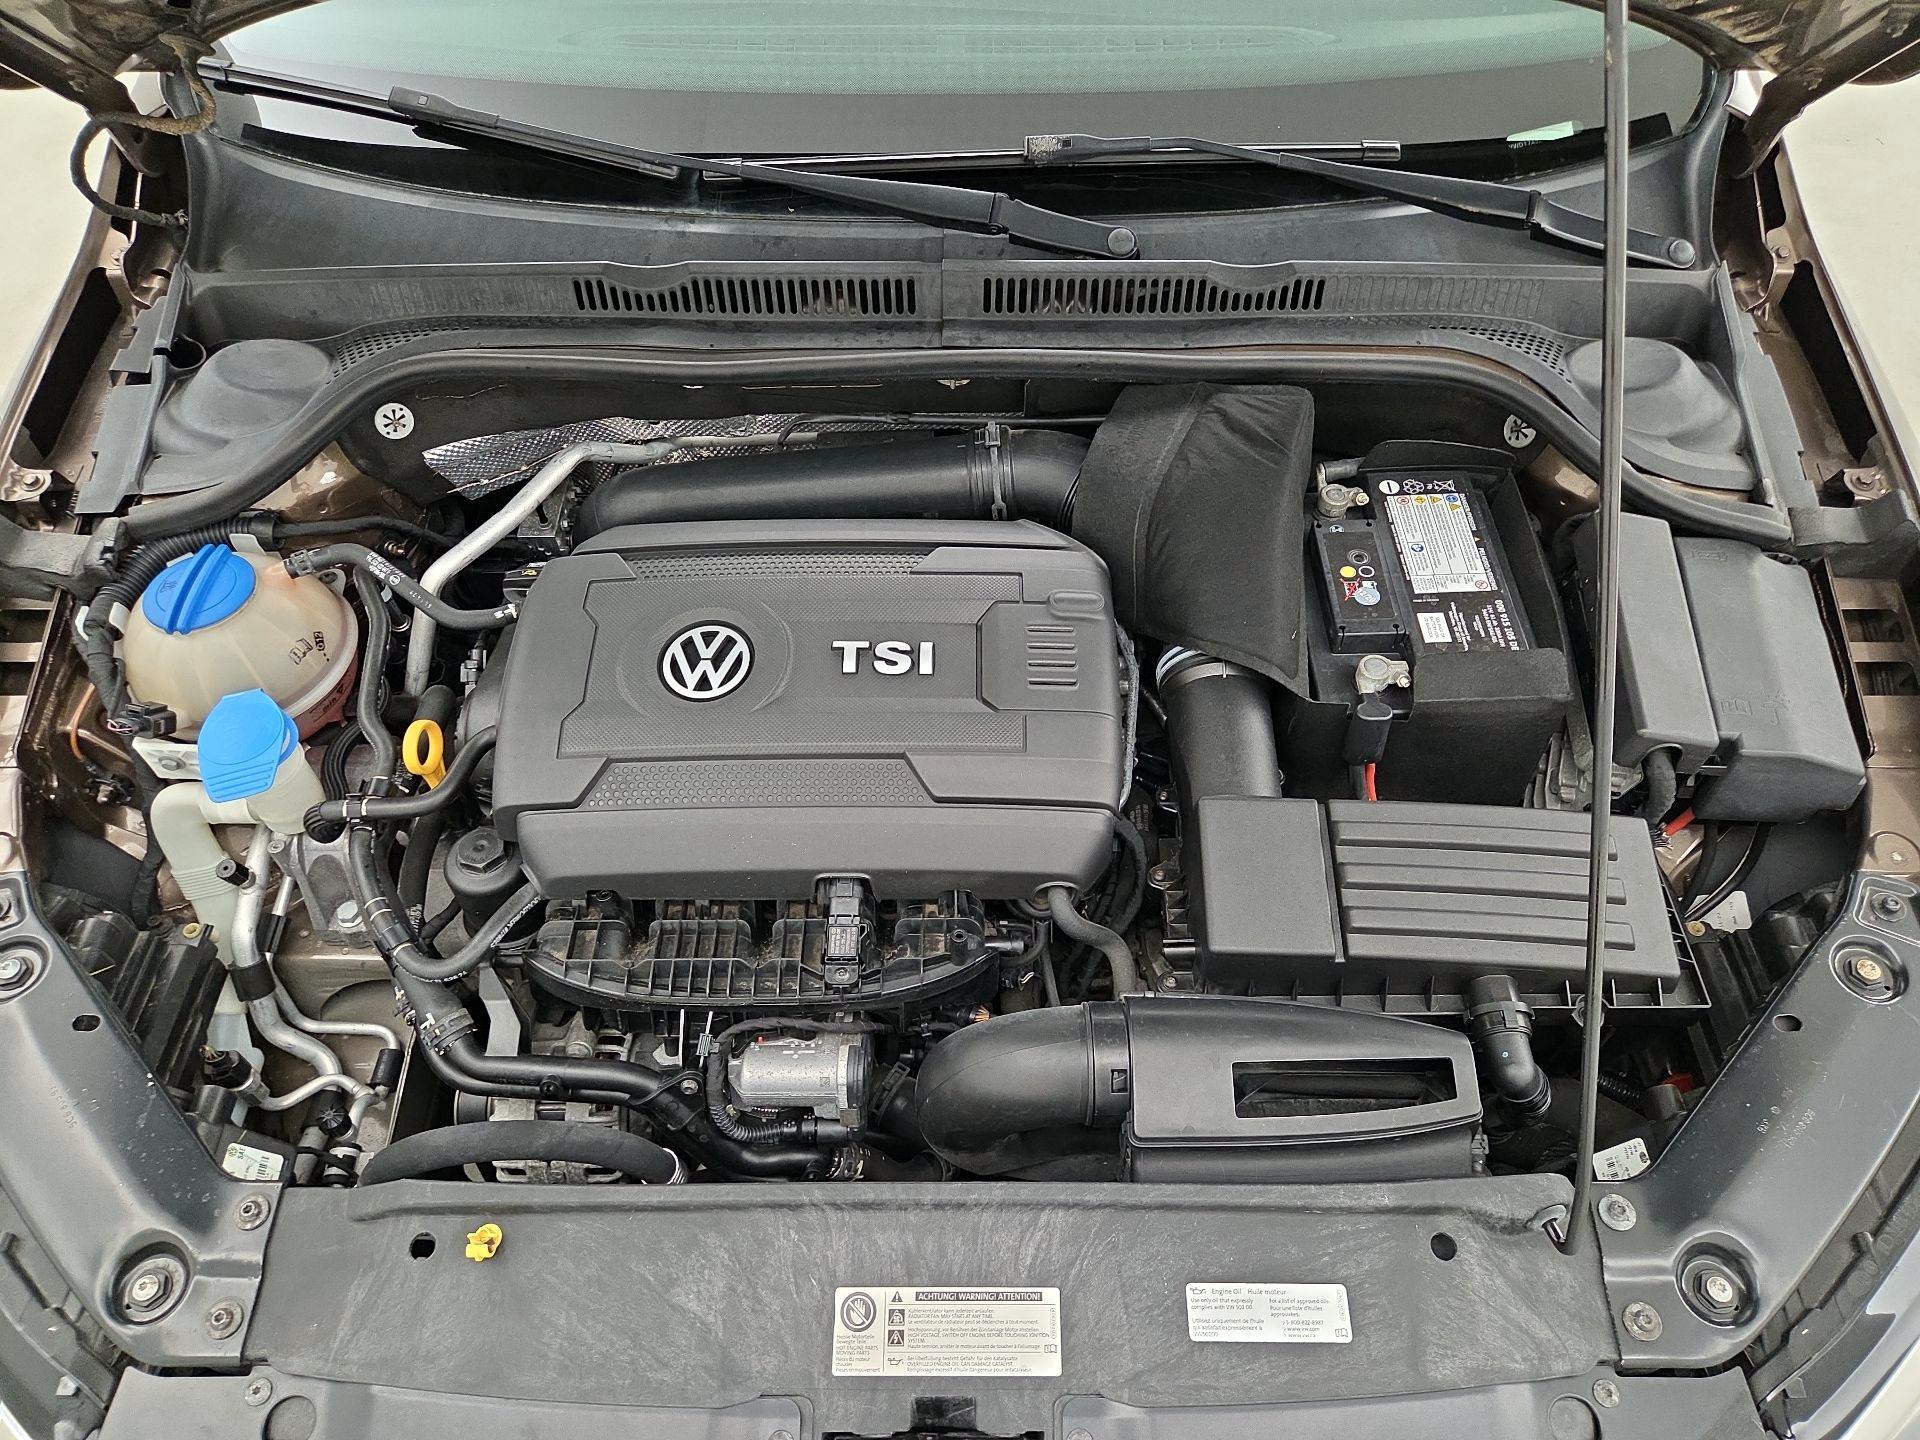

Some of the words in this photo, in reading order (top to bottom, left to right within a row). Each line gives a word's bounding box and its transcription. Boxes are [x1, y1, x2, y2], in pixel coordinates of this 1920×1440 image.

[831, 640, 935, 675] TSI
[918, 1292, 957, 1301] ACHTUNG!
[958, 1292, 996, 1301] WARNING!
[998, 1292, 1041, 1301] ATTENTION!
[1211, 1288, 1232, 1296] Engine
